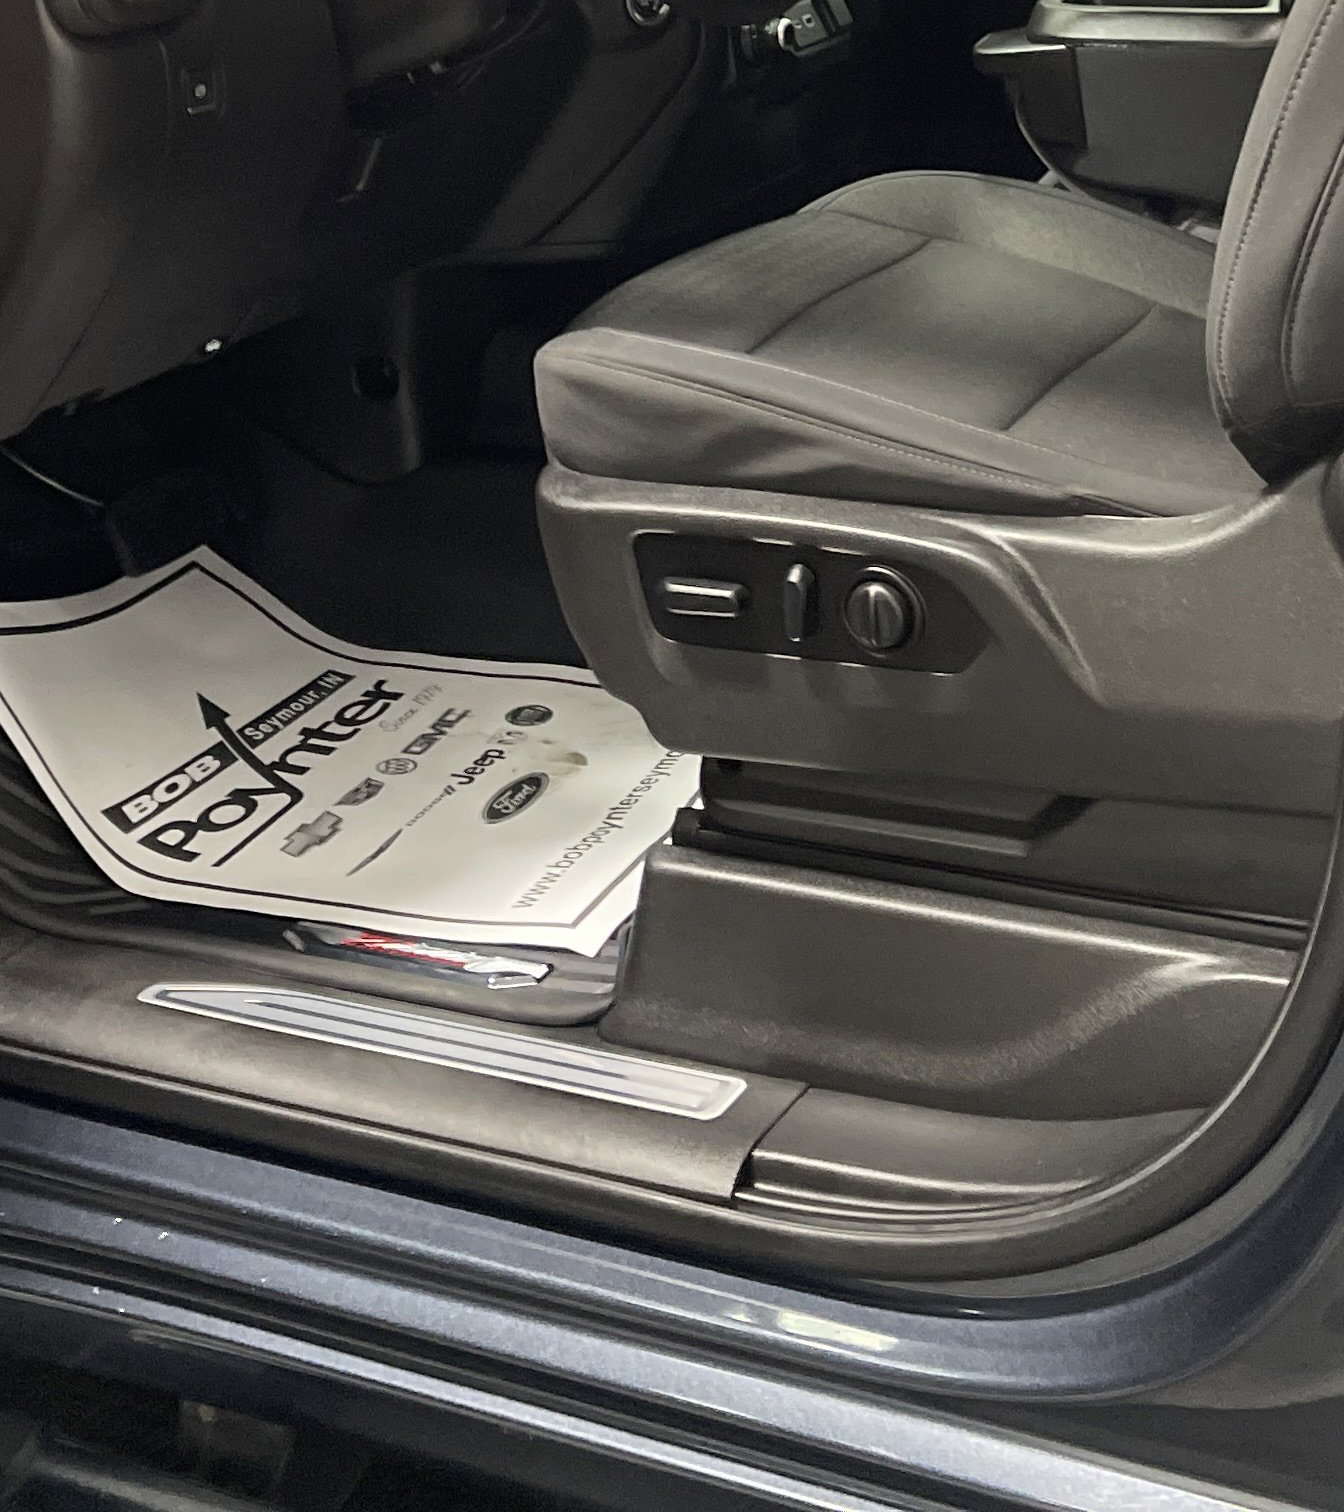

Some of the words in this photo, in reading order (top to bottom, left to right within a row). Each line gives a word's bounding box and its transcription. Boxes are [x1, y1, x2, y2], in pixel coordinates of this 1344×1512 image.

[121, 754, 222, 825] BOB
[316, 671, 345, 689] IN
[401, 707, 473, 756] GMC
[137, 679, 405, 864] Poynter
[450, 747, 506, 786] Jeep
[493, 782, 538, 814] Ford
